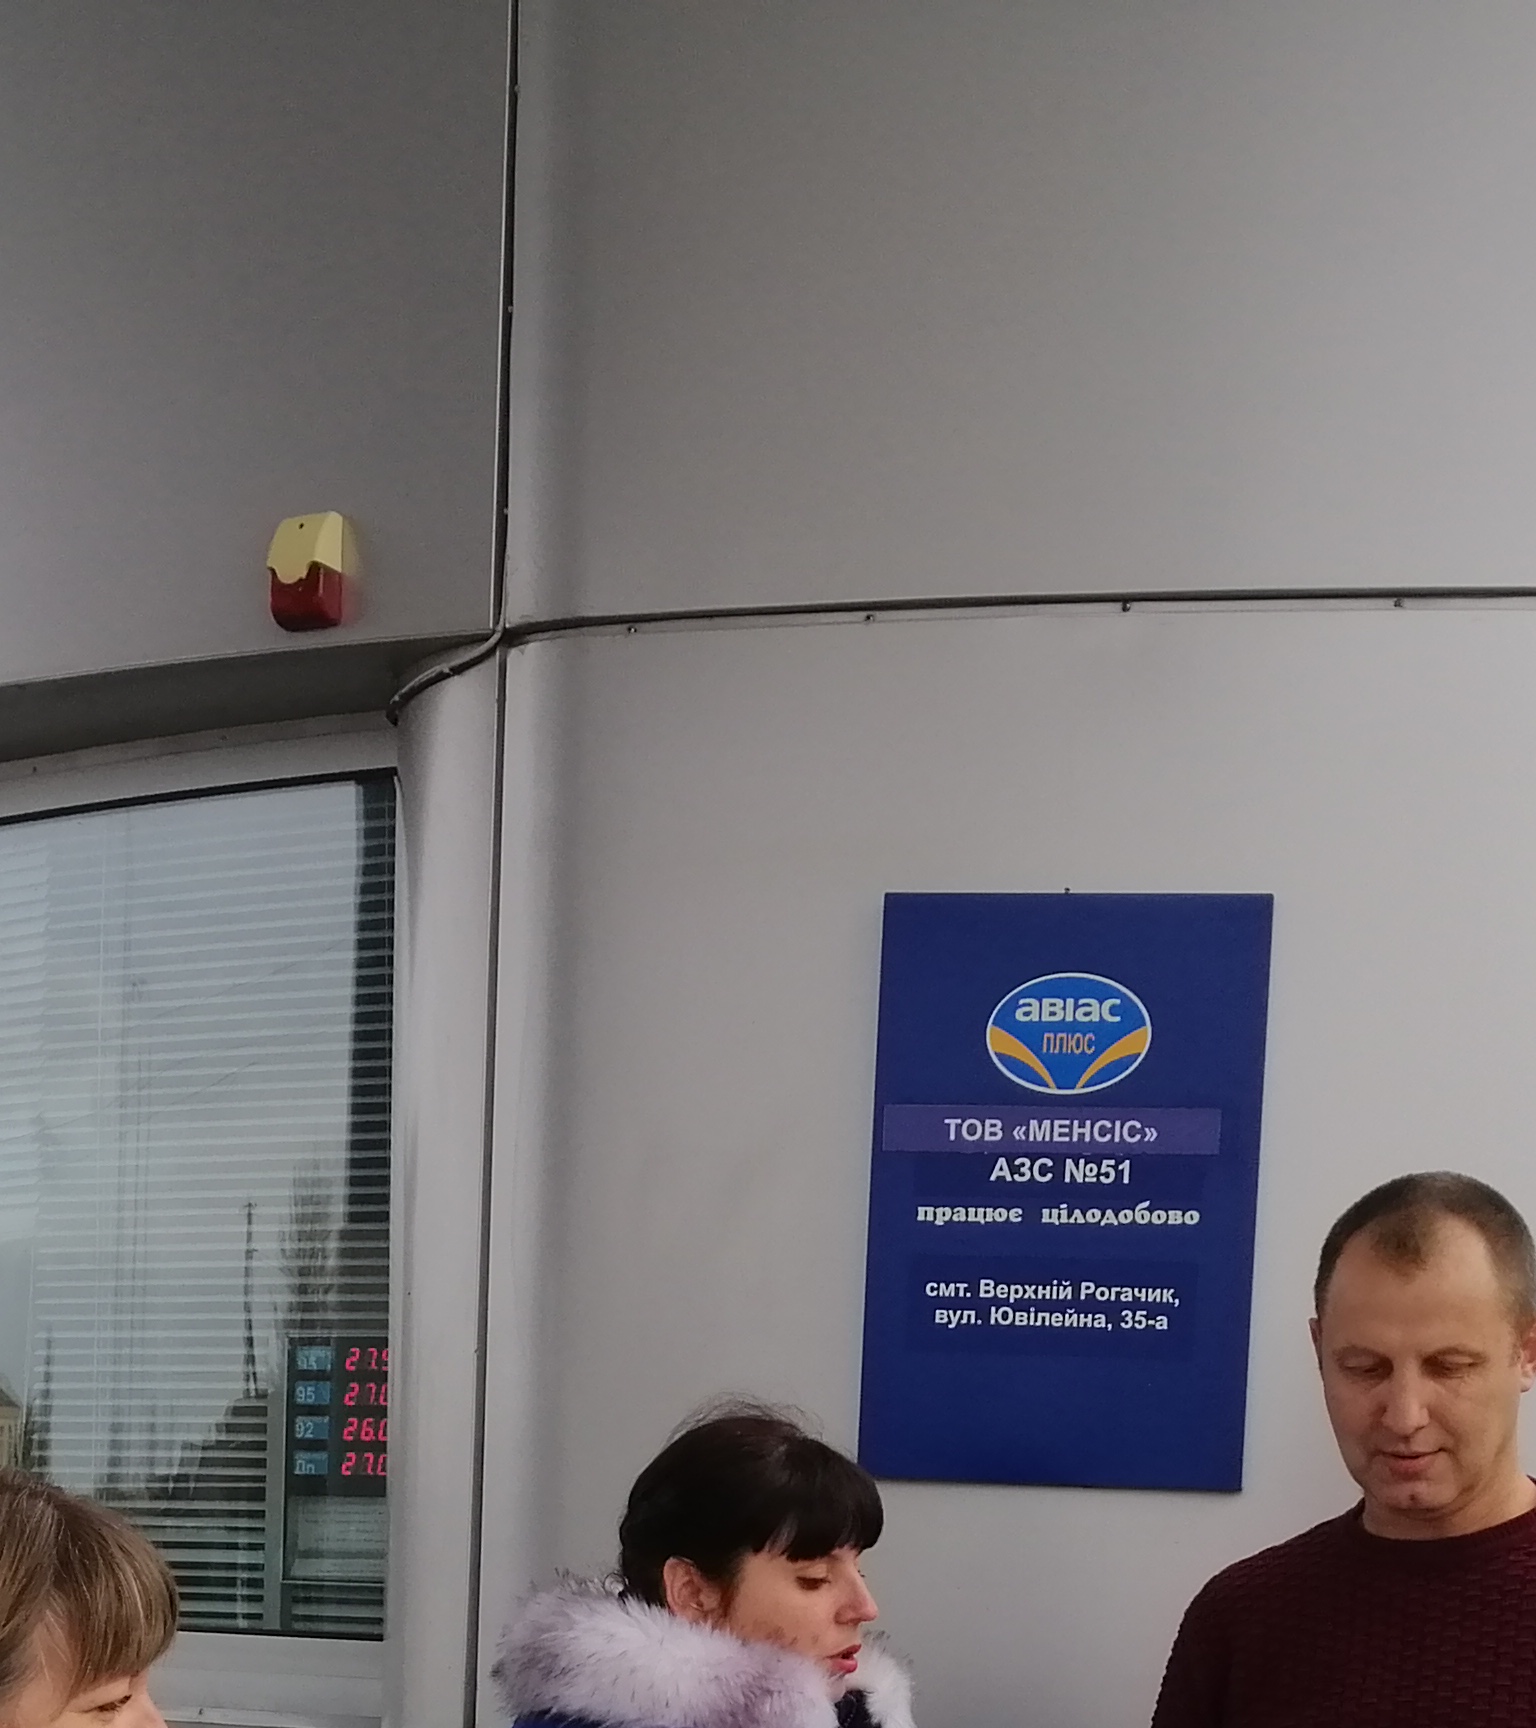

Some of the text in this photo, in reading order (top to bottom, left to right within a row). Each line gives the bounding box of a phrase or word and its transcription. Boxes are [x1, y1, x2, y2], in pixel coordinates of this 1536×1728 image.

[1042, 1032, 1096, 1055] ПЛЮС
[944, 1118, 1159, 1143] ТОВ «МЕНСІС»
[989, 1157, 1132, 1184] АЗС №51
[916, 1200, 1201, 1226] працює цілодобово
[925, 1279, 1180, 1307] смт. Верхній Рогачик,
[934, 1306, 1169, 1331] вул. Ювілейна, 35-а
[295, 1386, 315, 1402] 95
[295, 1421, 314, 1438] 92
